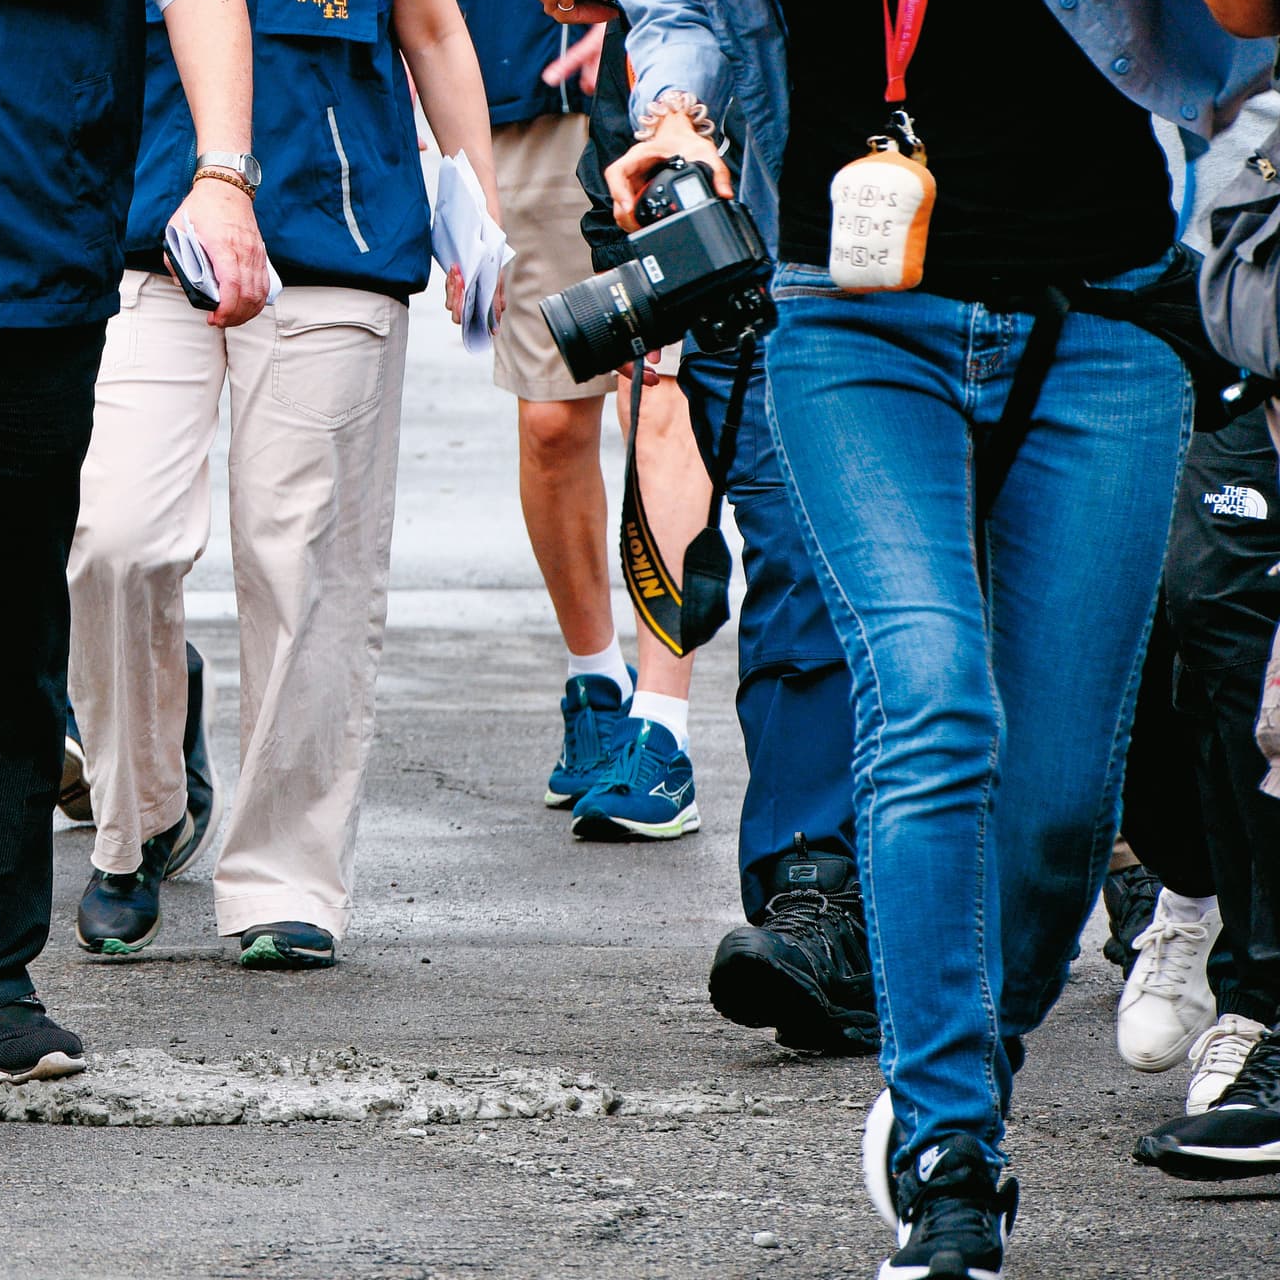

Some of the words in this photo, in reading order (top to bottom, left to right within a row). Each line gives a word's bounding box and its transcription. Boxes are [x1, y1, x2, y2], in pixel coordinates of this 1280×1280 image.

[323, 3, 349, 19] 臺北
[1222, 485, 1248, 496] THE
[1203, 493, 1247, 507] NORTH
[1212, 503, 1246, 516] FACE
[626, 521, 666, 599] Nikon
